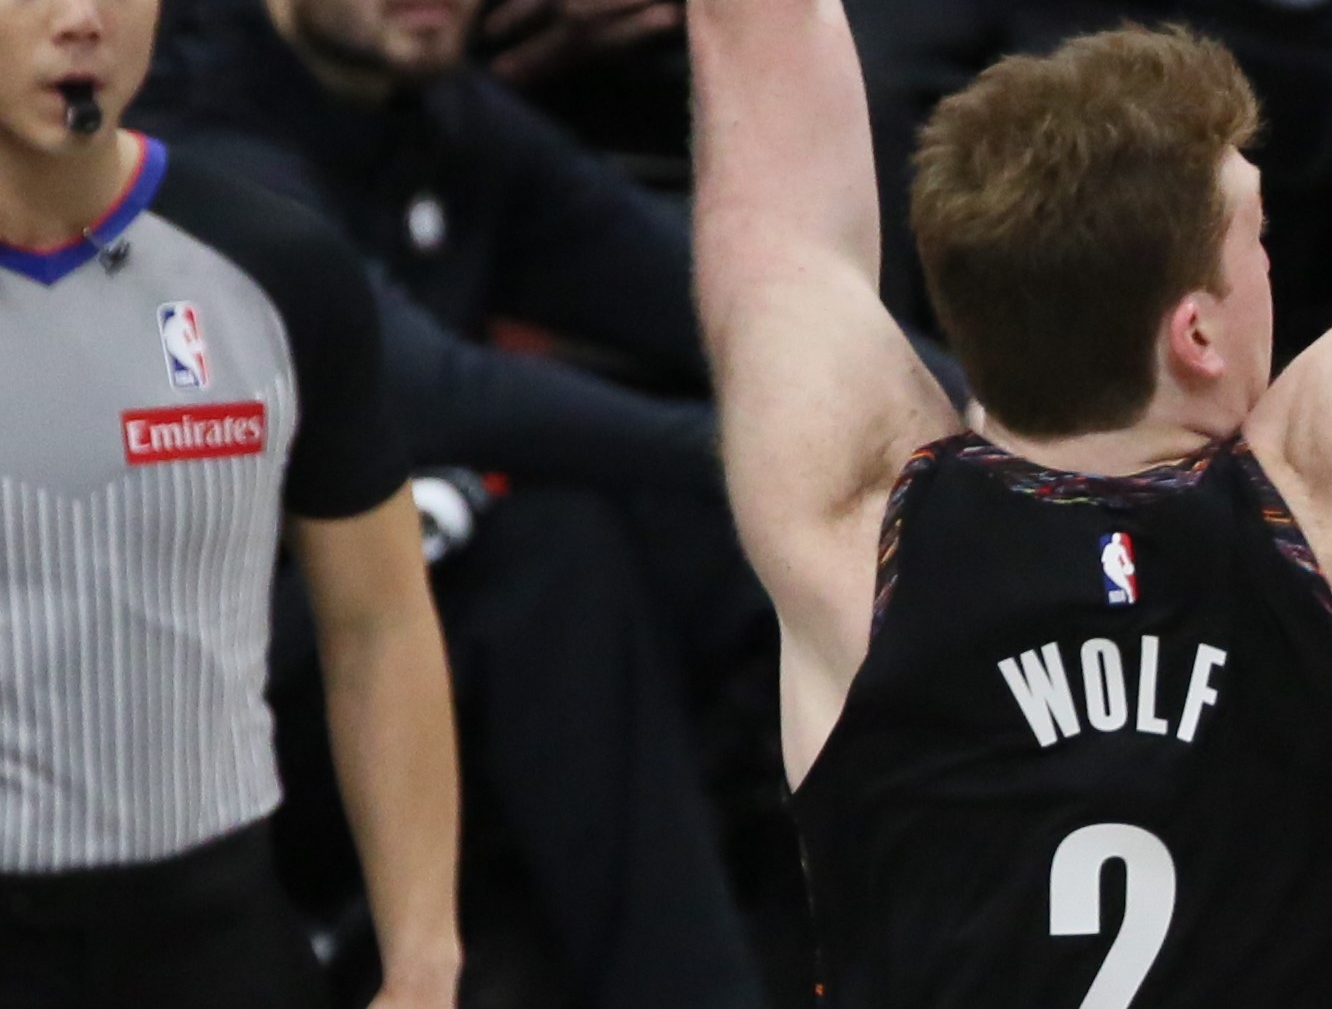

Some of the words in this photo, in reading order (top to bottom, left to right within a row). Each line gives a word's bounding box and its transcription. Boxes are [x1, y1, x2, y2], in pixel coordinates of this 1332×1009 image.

[126, 414, 261, 454] Emirates
[997, 635, 1227, 748] WOLF
[1049, 822, 1177, 1009] 2
